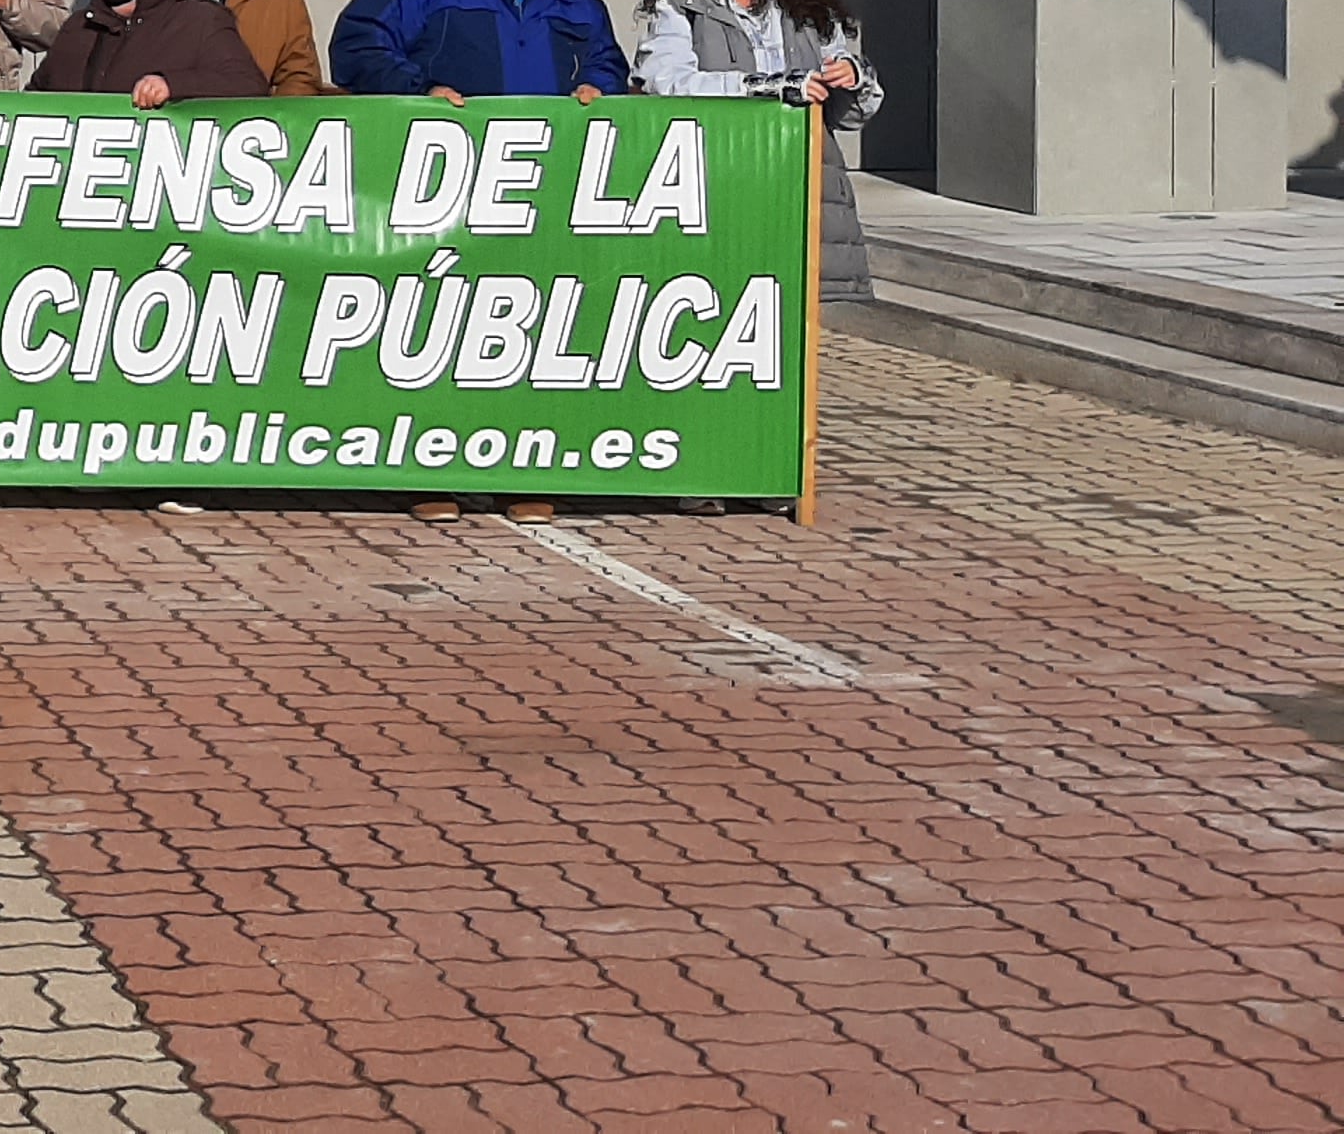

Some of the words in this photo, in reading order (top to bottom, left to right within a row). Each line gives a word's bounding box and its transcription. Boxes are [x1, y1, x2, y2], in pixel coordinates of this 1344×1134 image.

[388, 118, 553, 235] DE
[569, 118, 708, 235] LA
[300, 246, 782, 392] PÚBLICA
